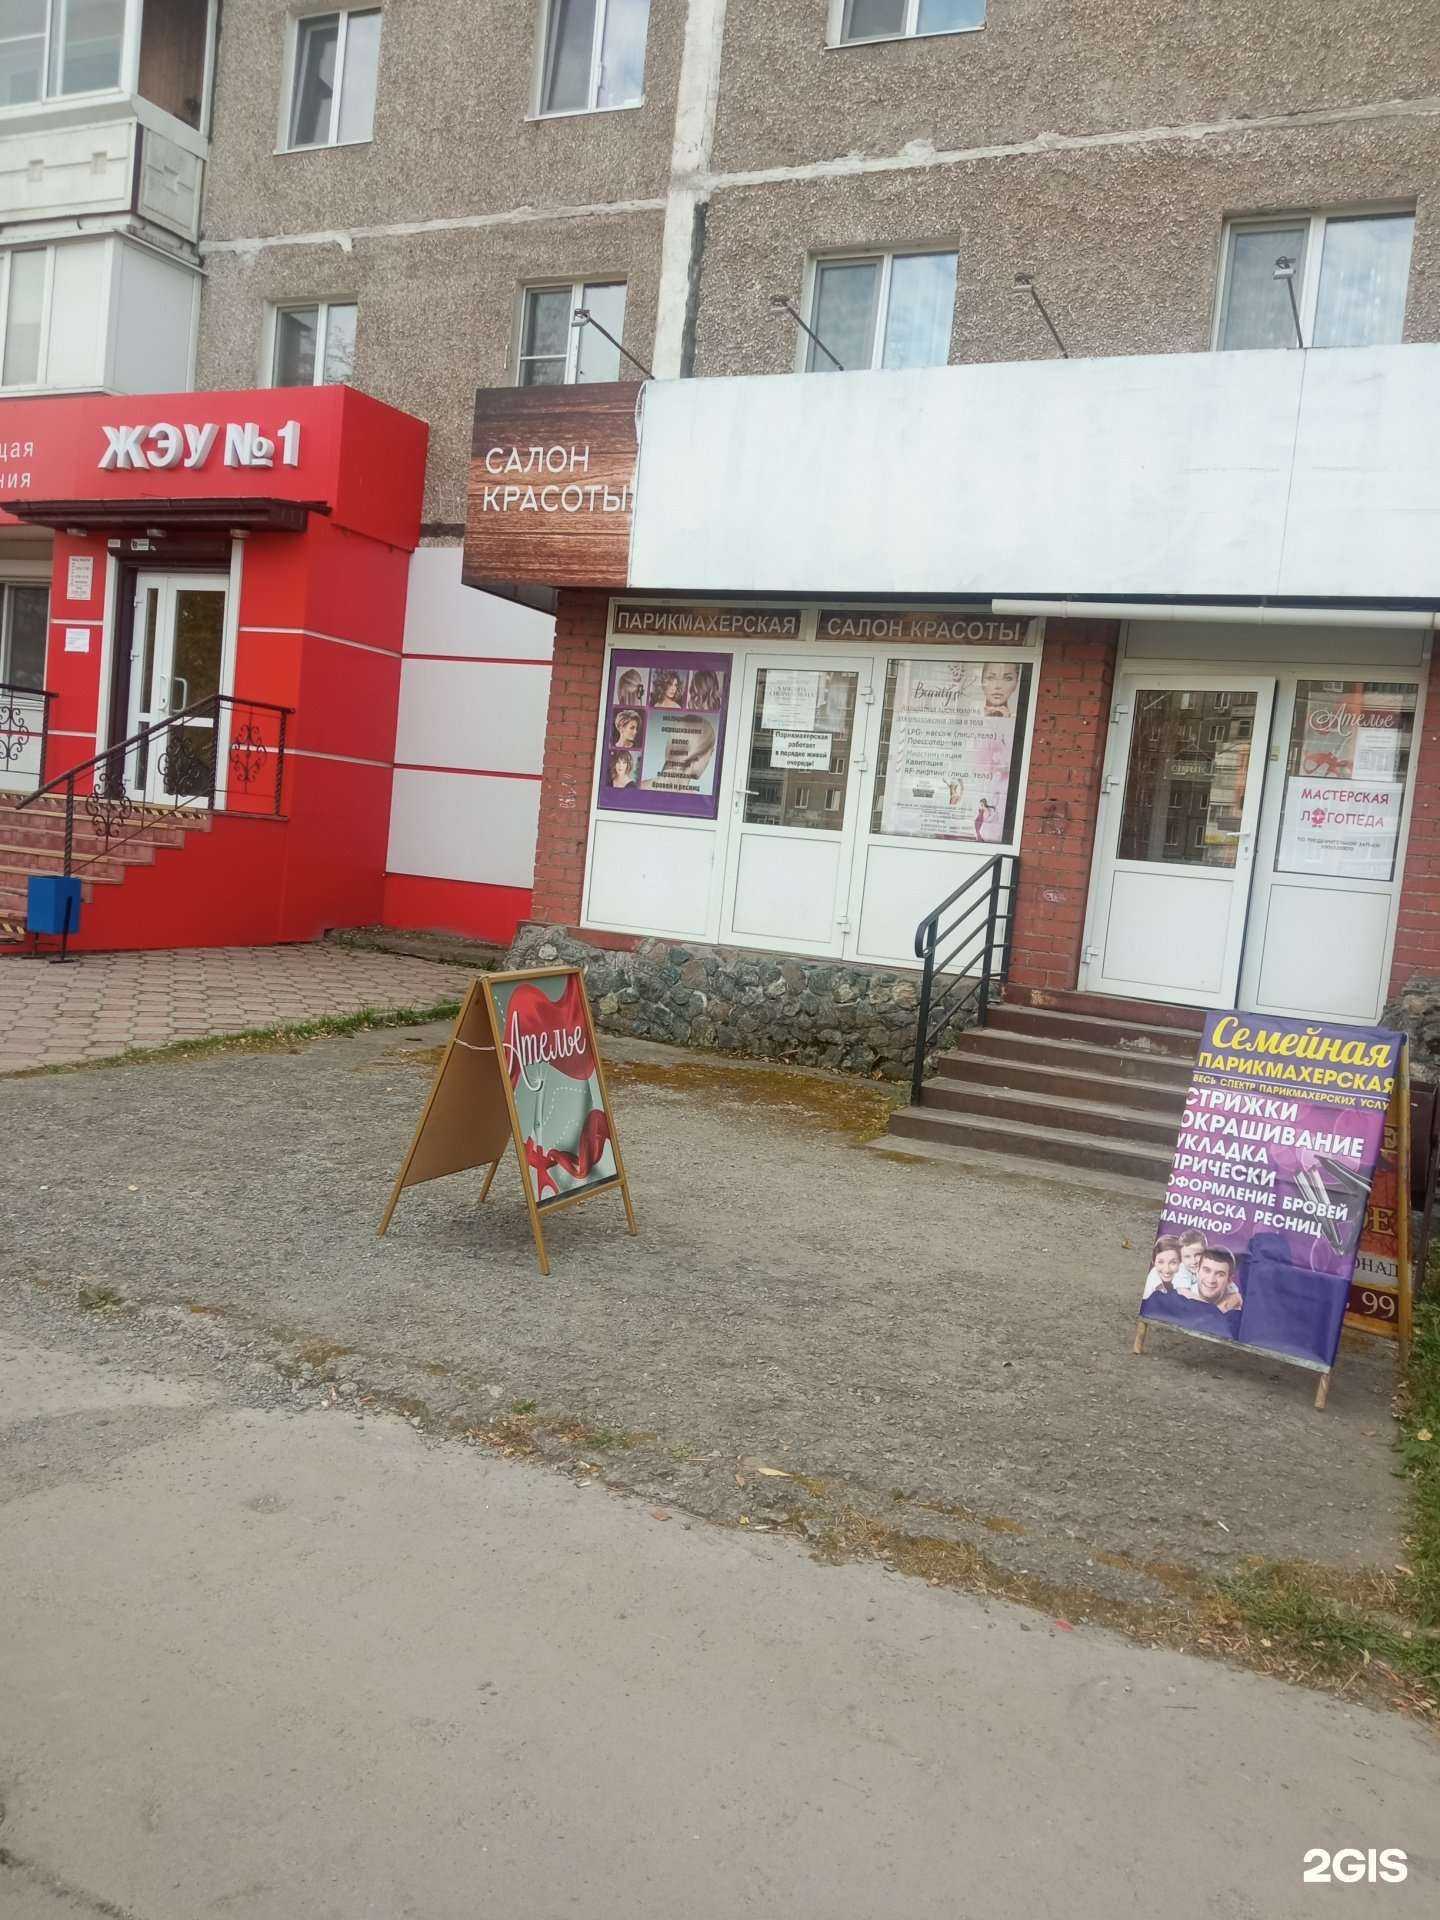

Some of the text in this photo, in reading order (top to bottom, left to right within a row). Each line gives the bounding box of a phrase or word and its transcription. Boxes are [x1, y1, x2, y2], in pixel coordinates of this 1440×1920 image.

[97, 423, 219, 470] ЖЭУ
[485, 445, 590, 474] САЛОН
[482, 484, 629, 513] КРАСОТЫ
[617, 611, 797, 634] ПАРИКМАХЕРСКАЯ
[826, 617, 1020, 641] САЛОН КРАСОТЫ
[1310, 703, 1394, 737] Ателье
[775, 731, 829, 740] Парикмахерская
[780, 751, 805, 759] порядке
[1301, 789, 1390, 805] МАСТЕРСКАЯ
[503, 1011, 586, 1091] Ателье
[1211, 1015, 1393, 1069] Семейная
[1198, 1051, 1395, 1095] ПАРИКМАХЕРСКАЯ
[1185, 1086, 1299, 1122] СТРИЖКИ
[1220, 1078, 1257, 1091] СПЕКТР
[1258, 1083, 1357, 1106] ПАРИКМАХЕРСКИХ
[1177, 1132, 1269, 1165] УКЛАДКА
[1180, 1109, 1366, 1159] ОКРАШИВАНИЕ
[1282, 1195, 1350, 1222] БРОВЕЙ
[1253, 1209, 1323, 1239] РЕСНИЦ
[1361, 1291, 1395, 1319] 99
